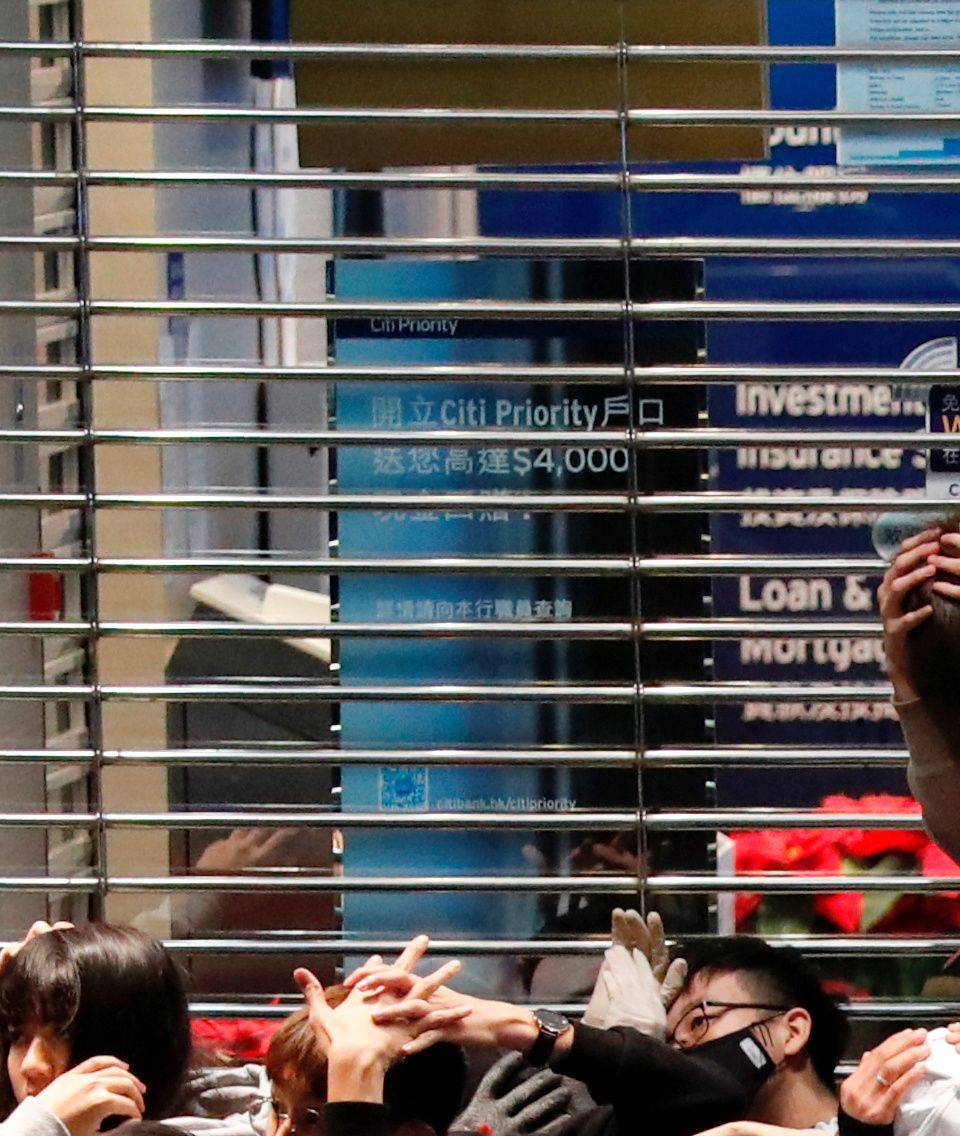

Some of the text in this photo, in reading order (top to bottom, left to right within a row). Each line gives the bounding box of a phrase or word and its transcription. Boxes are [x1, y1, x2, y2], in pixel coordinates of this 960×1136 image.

[371, 318, 458, 336] Citi Priority
[739, 574, 873, 612] Loan &
